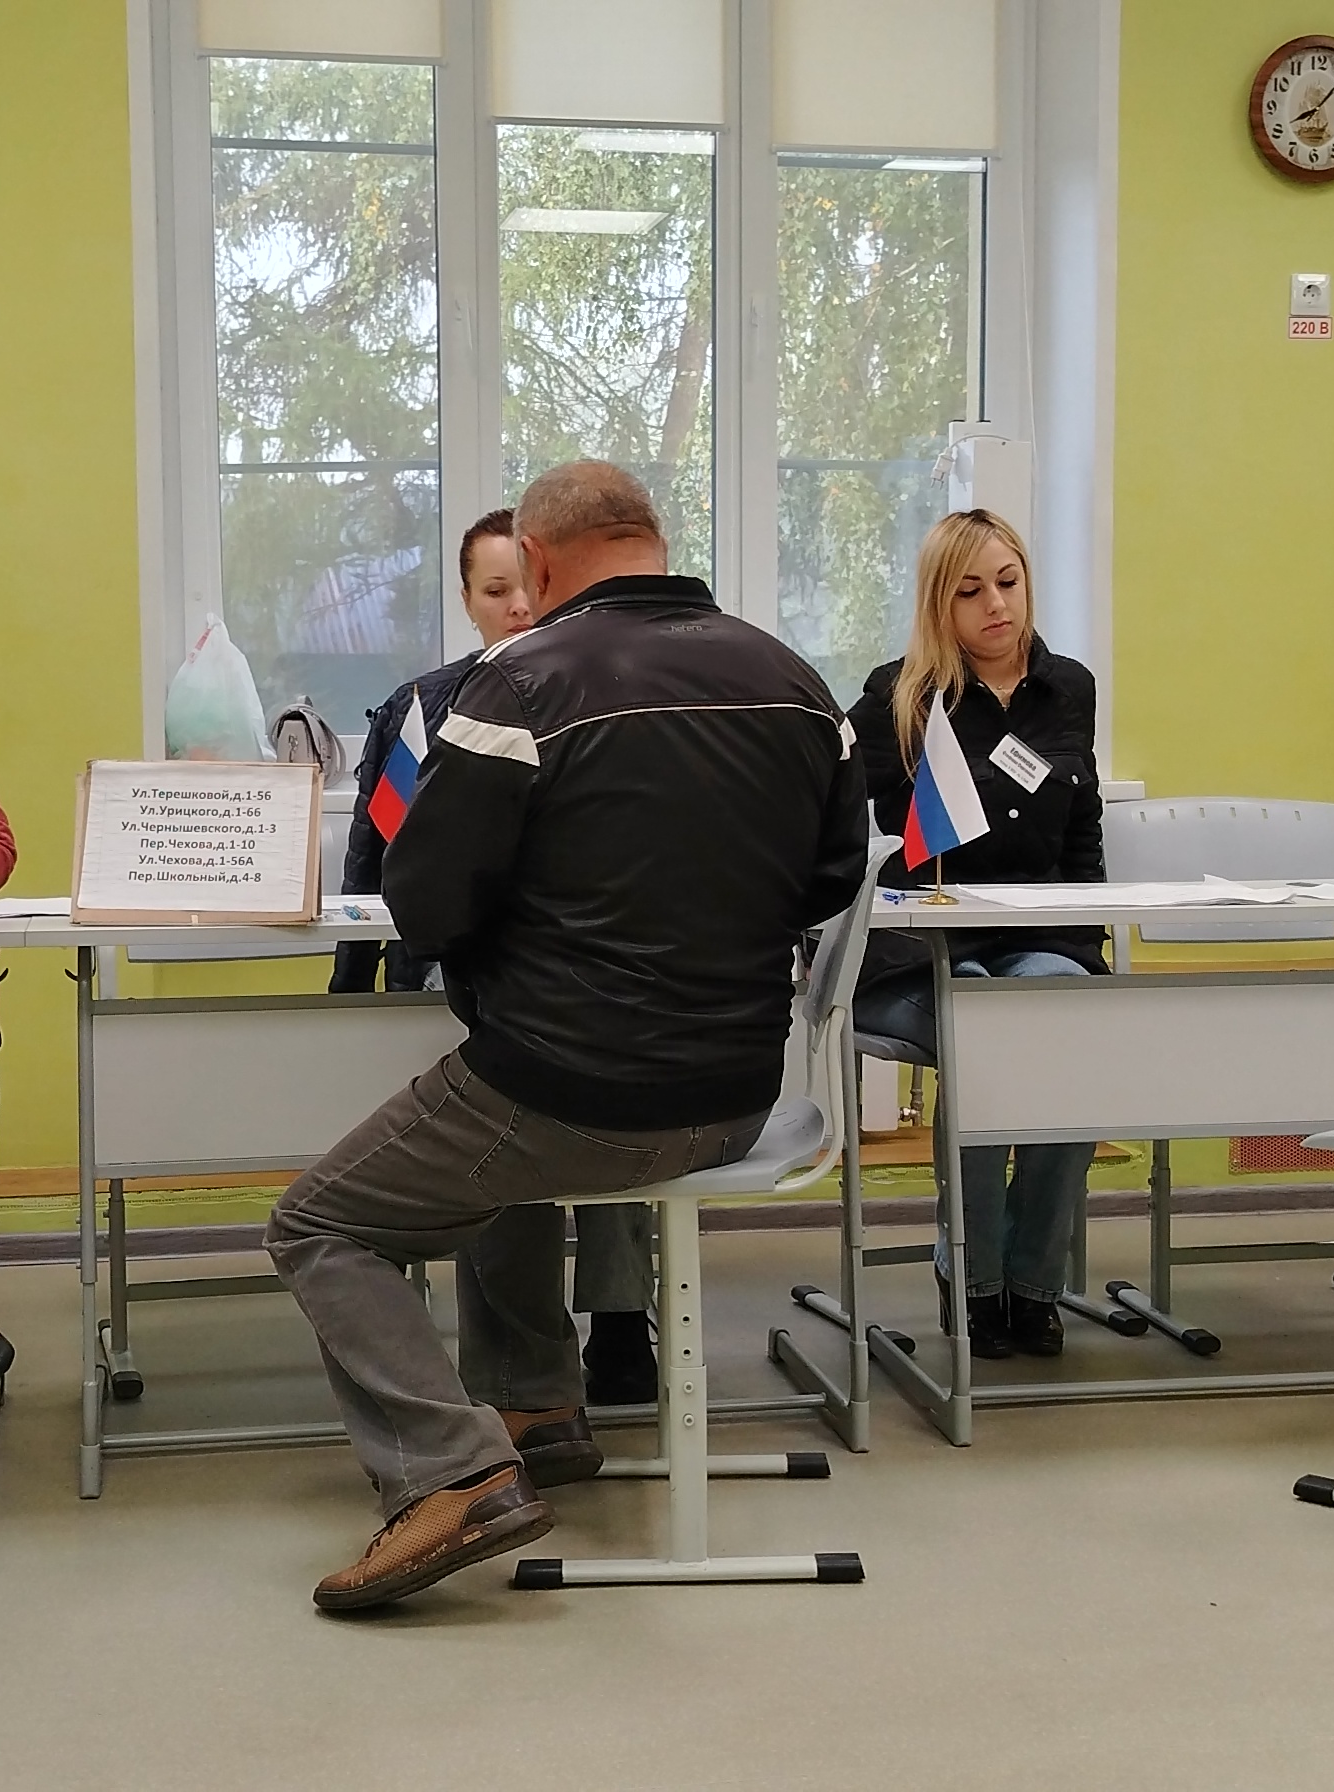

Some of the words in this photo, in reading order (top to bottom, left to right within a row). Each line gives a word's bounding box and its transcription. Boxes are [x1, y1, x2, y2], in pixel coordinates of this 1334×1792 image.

[1292, 321, 1315, 335] 220
[1319, 321, 1329, 335] В
[131, 787, 272, 802] Ул.Терешковой,д.1-56
[139, 804, 262, 819] Ул.Урицкого,д.1-66
[121, 820, 277, 835] Ул.Чернышевского,д.1-3
[140, 837, 256, 852] Пер.Чехова,д.1-10
[138, 854, 255, 868] Ул.Чехова,д.1-56А
[128, 870, 262, 885] Пер.Школьный,д.4-8
